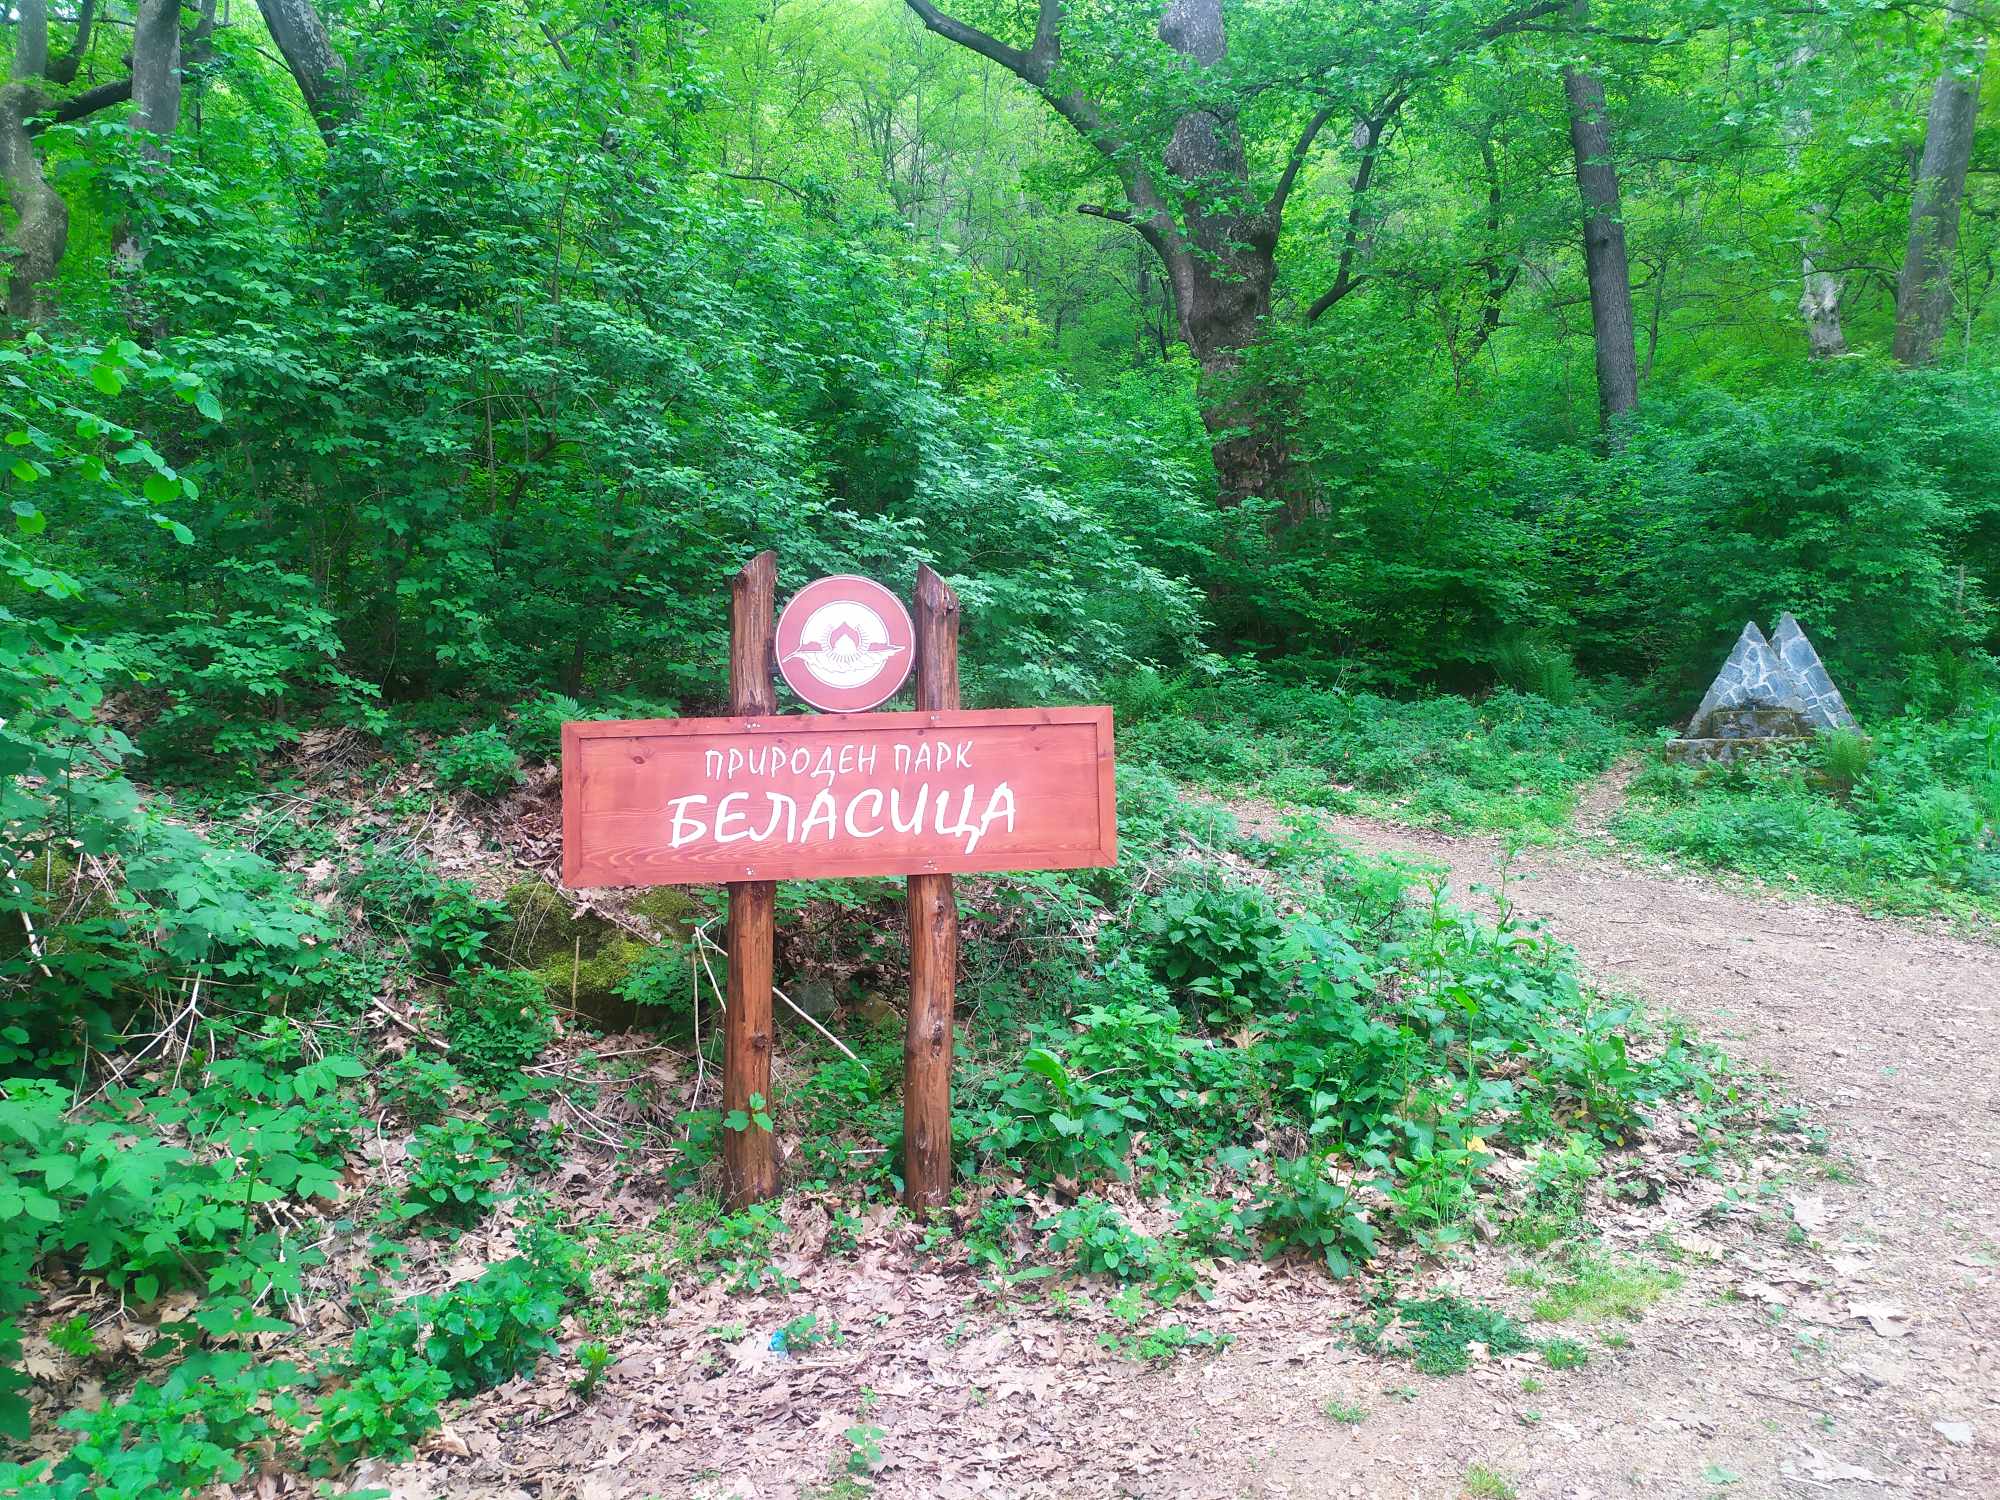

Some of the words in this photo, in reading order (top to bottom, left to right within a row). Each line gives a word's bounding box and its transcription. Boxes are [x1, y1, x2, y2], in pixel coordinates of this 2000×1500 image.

[704, 744, 877, 787] ПРИРОДЕН
[893, 740, 975, 775] ПАРК
[667, 781, 1017, 855] БЕЛАСИЦА
